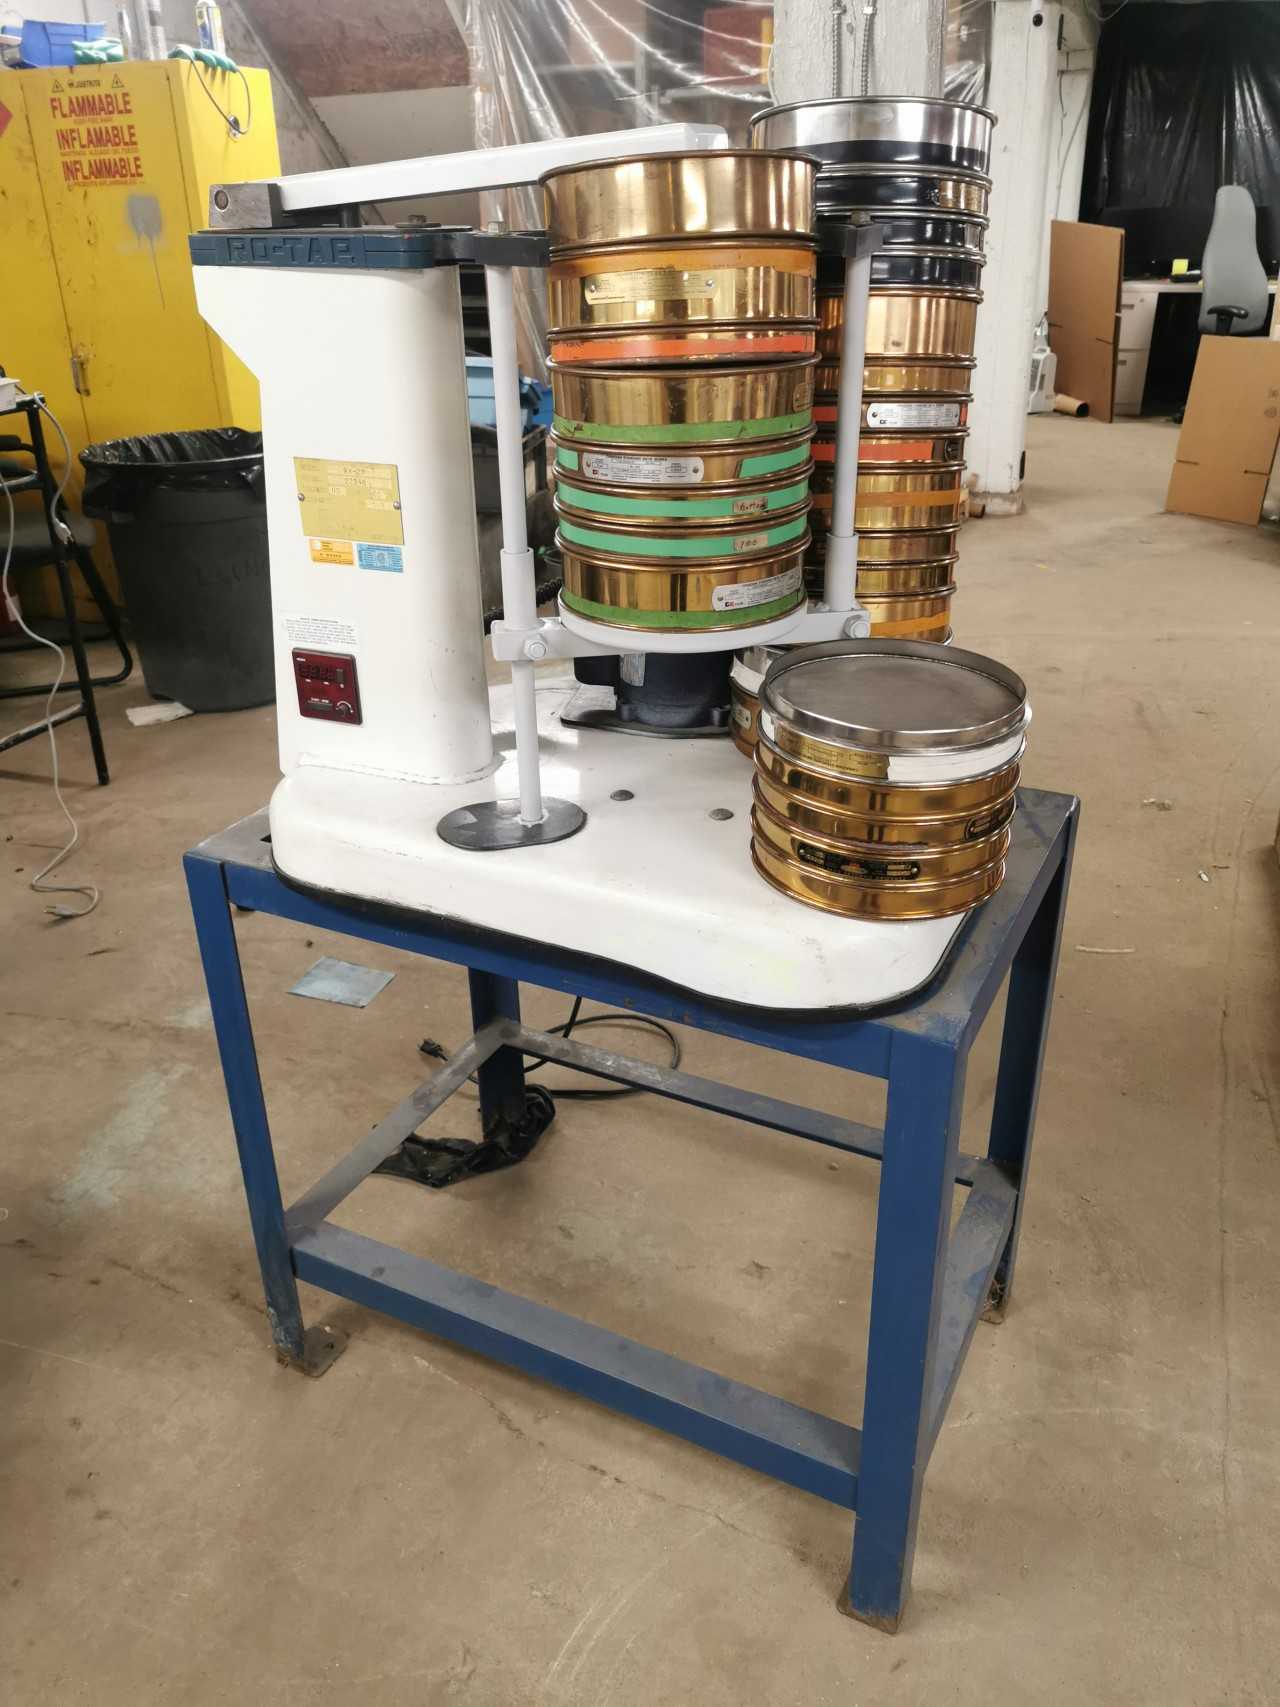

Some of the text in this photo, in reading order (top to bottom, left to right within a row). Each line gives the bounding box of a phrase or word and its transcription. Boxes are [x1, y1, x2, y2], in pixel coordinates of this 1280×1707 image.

[49, 92, 133, 119] FLAMMABLE
[56, 124, 138, 150] INFLAMABLE
[62, 156, 144, 181] INFLAMMABLE
[226, 236, 352, 264] RO-TAP
